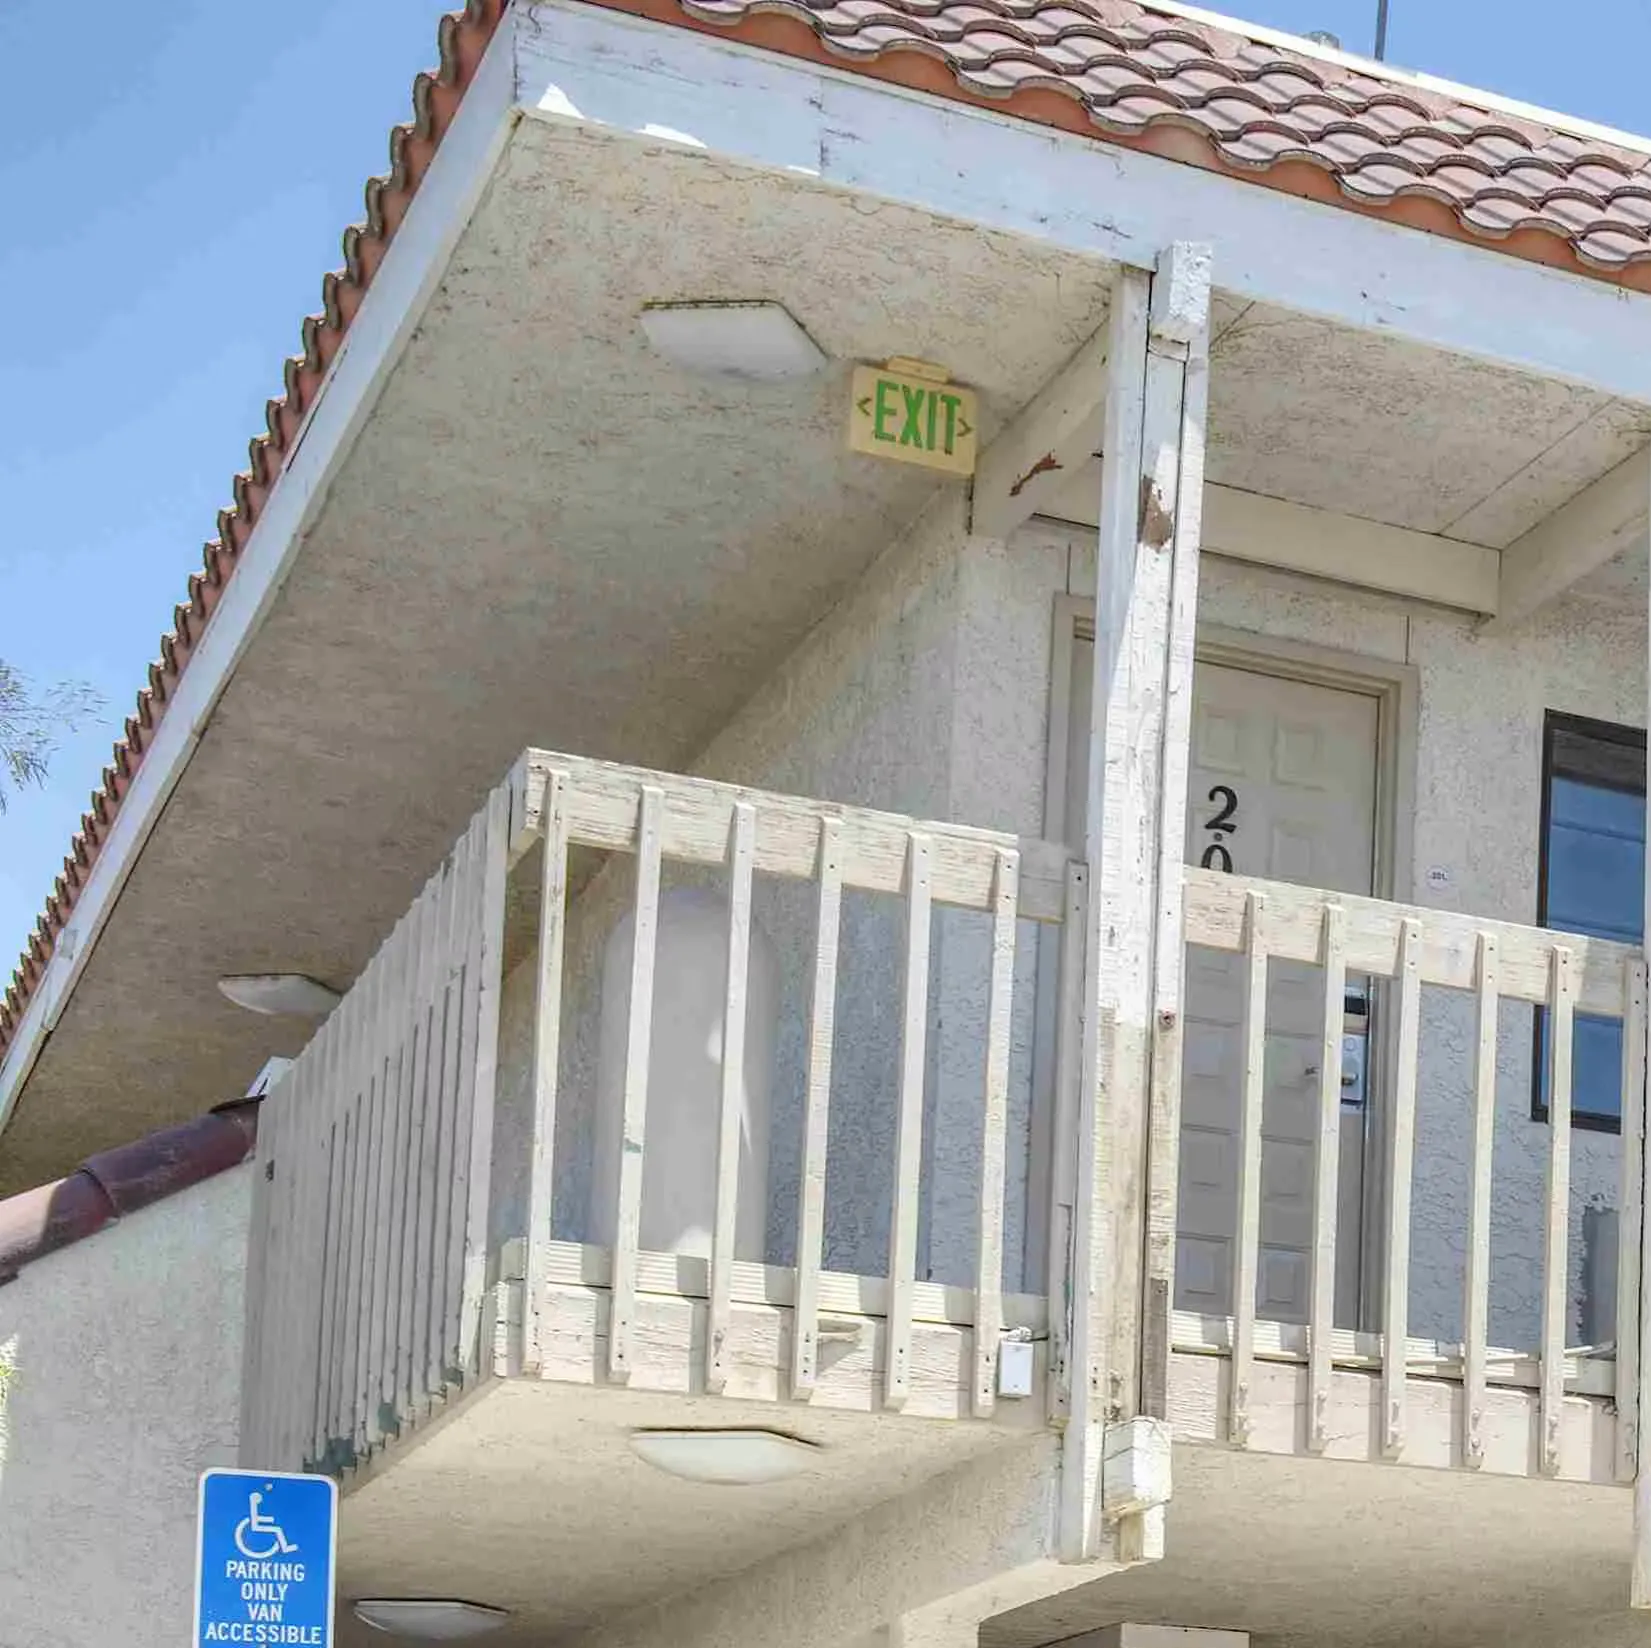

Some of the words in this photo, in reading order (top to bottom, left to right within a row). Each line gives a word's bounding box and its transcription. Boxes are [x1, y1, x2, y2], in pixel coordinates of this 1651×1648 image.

[875, 378, 962, 455] EXIT
[226, 1560, 305, 1582] PARKING
[241, 1583, 289, 1602] ONLY
[248, 1603, 283, 1622] VAN
[205, 1625, 322, 1645] ACCESSIBLE
